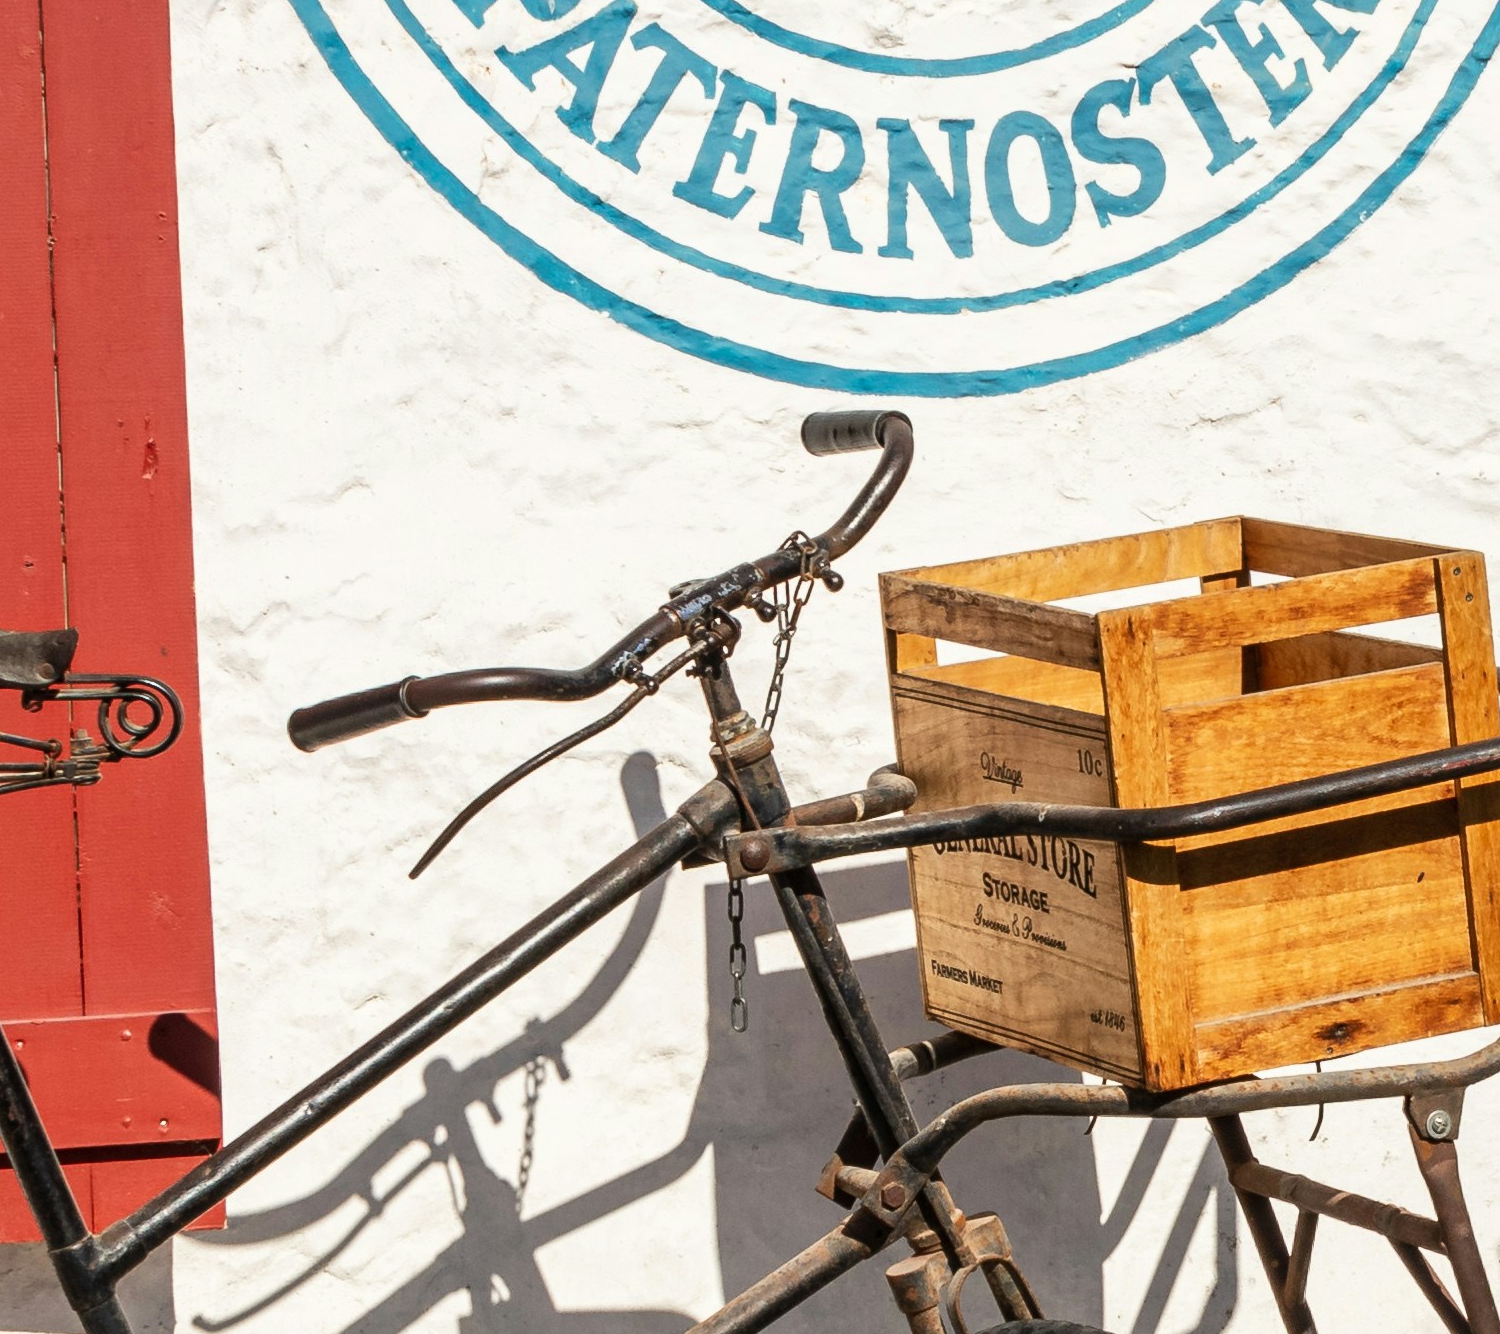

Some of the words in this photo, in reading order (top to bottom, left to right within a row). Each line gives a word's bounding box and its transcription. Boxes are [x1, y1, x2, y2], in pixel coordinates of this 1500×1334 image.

[980, 751, 1024, 794] Vintage
[1077, 749, 1103, 777] 10c
[1027, 835, 1097, 900] STORE
[982, 872, 1050, 913] STORAGE
[931, 959, 968, 985] FARMERS
[968, 969, 1004, 995] MARKET
